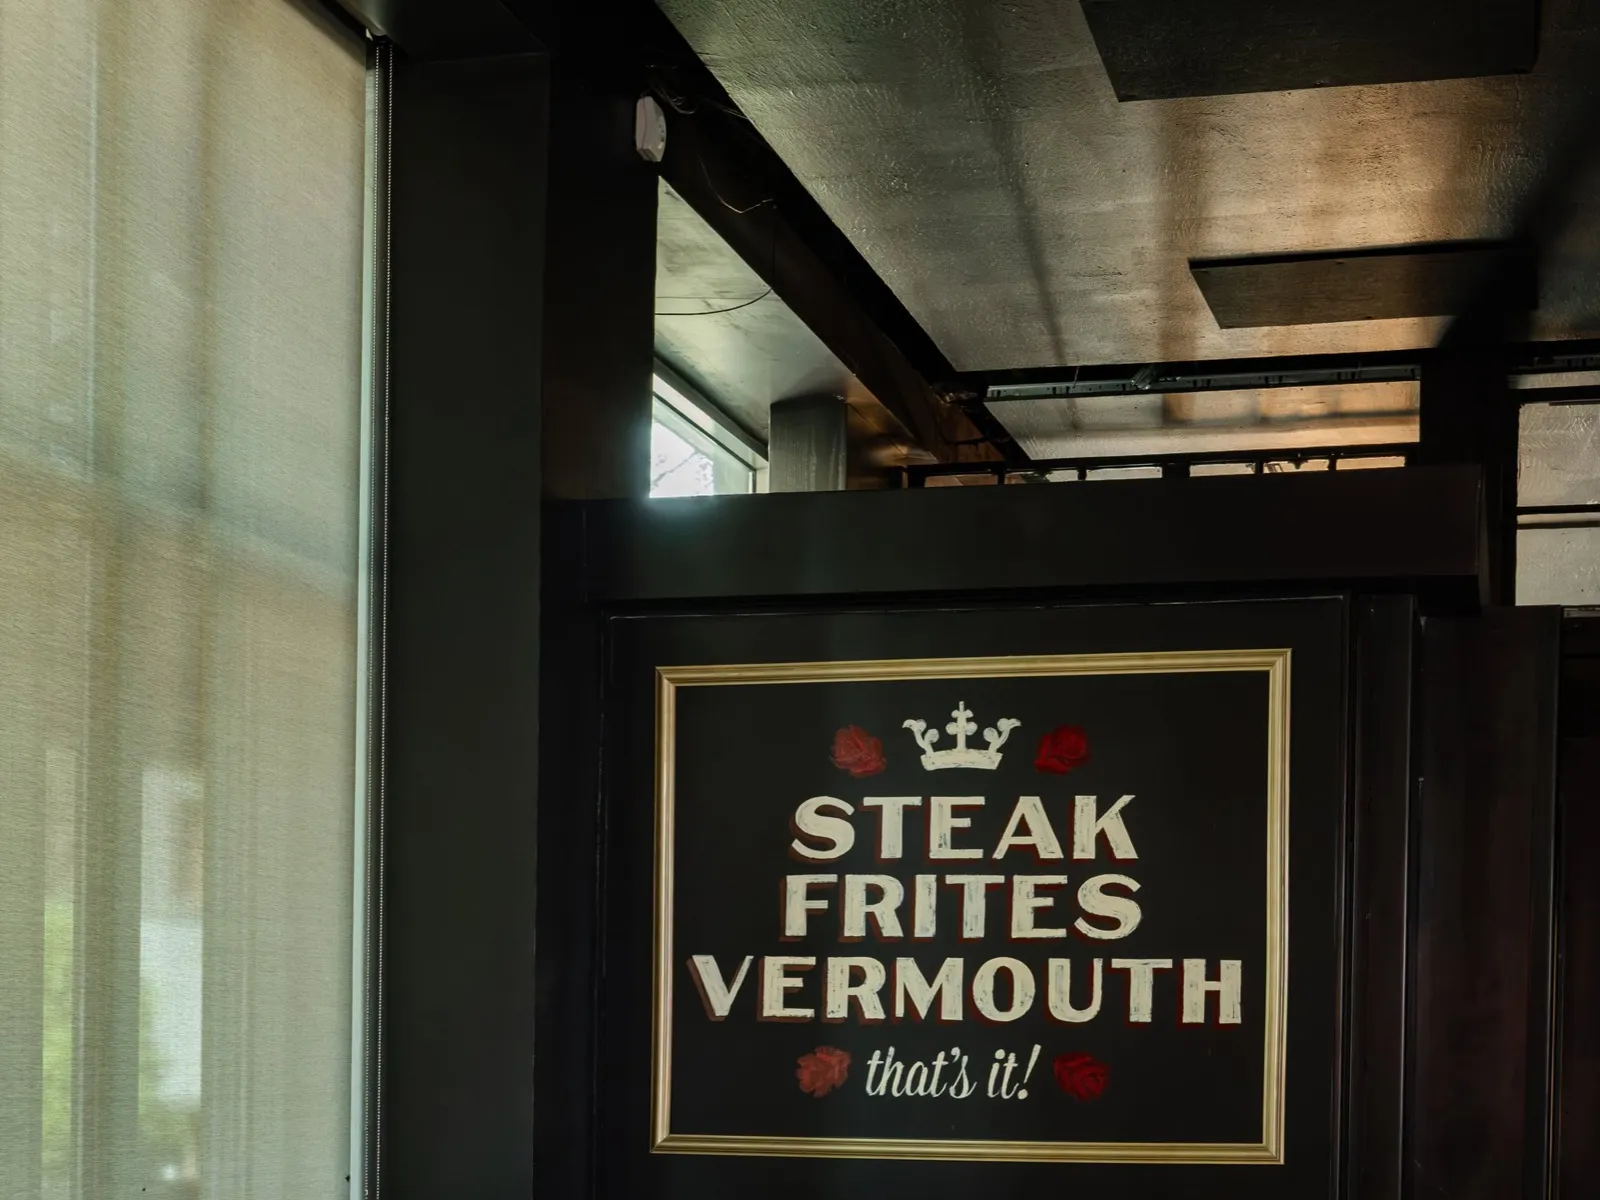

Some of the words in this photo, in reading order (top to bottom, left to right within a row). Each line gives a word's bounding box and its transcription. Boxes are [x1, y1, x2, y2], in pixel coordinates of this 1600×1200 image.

[790, 794, 1140, 861] STEAK
[783, 873, 1143, 941] FRITES
[690, 954, 1243, 1025] VERMOUTH
[865, 1045, 977, 1099] that's
[986, 1043, 1042, 1100] it!
